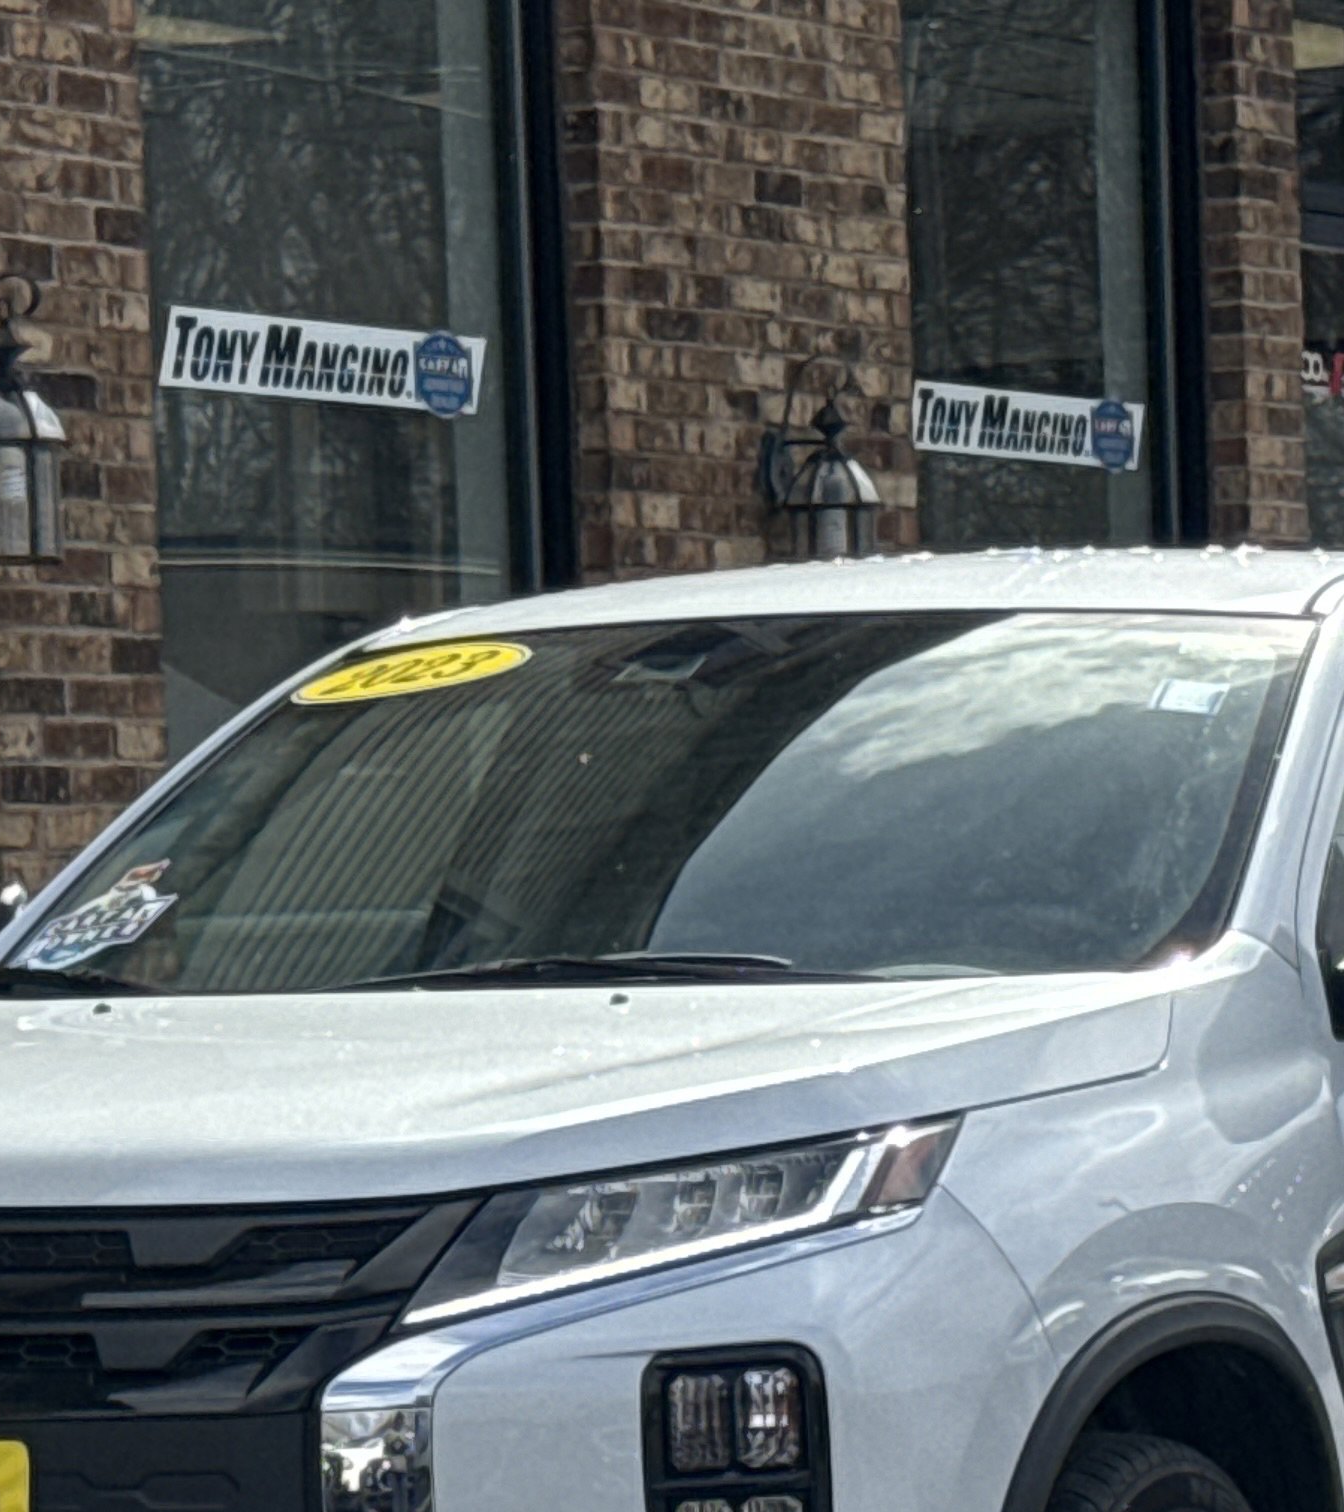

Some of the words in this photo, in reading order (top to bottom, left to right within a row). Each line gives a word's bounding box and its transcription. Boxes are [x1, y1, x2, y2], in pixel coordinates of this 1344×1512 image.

[171, 315, 259, 385] TONY
[915, 387, 979, 448] TONY
[318, 650, 501, 697] 2023
